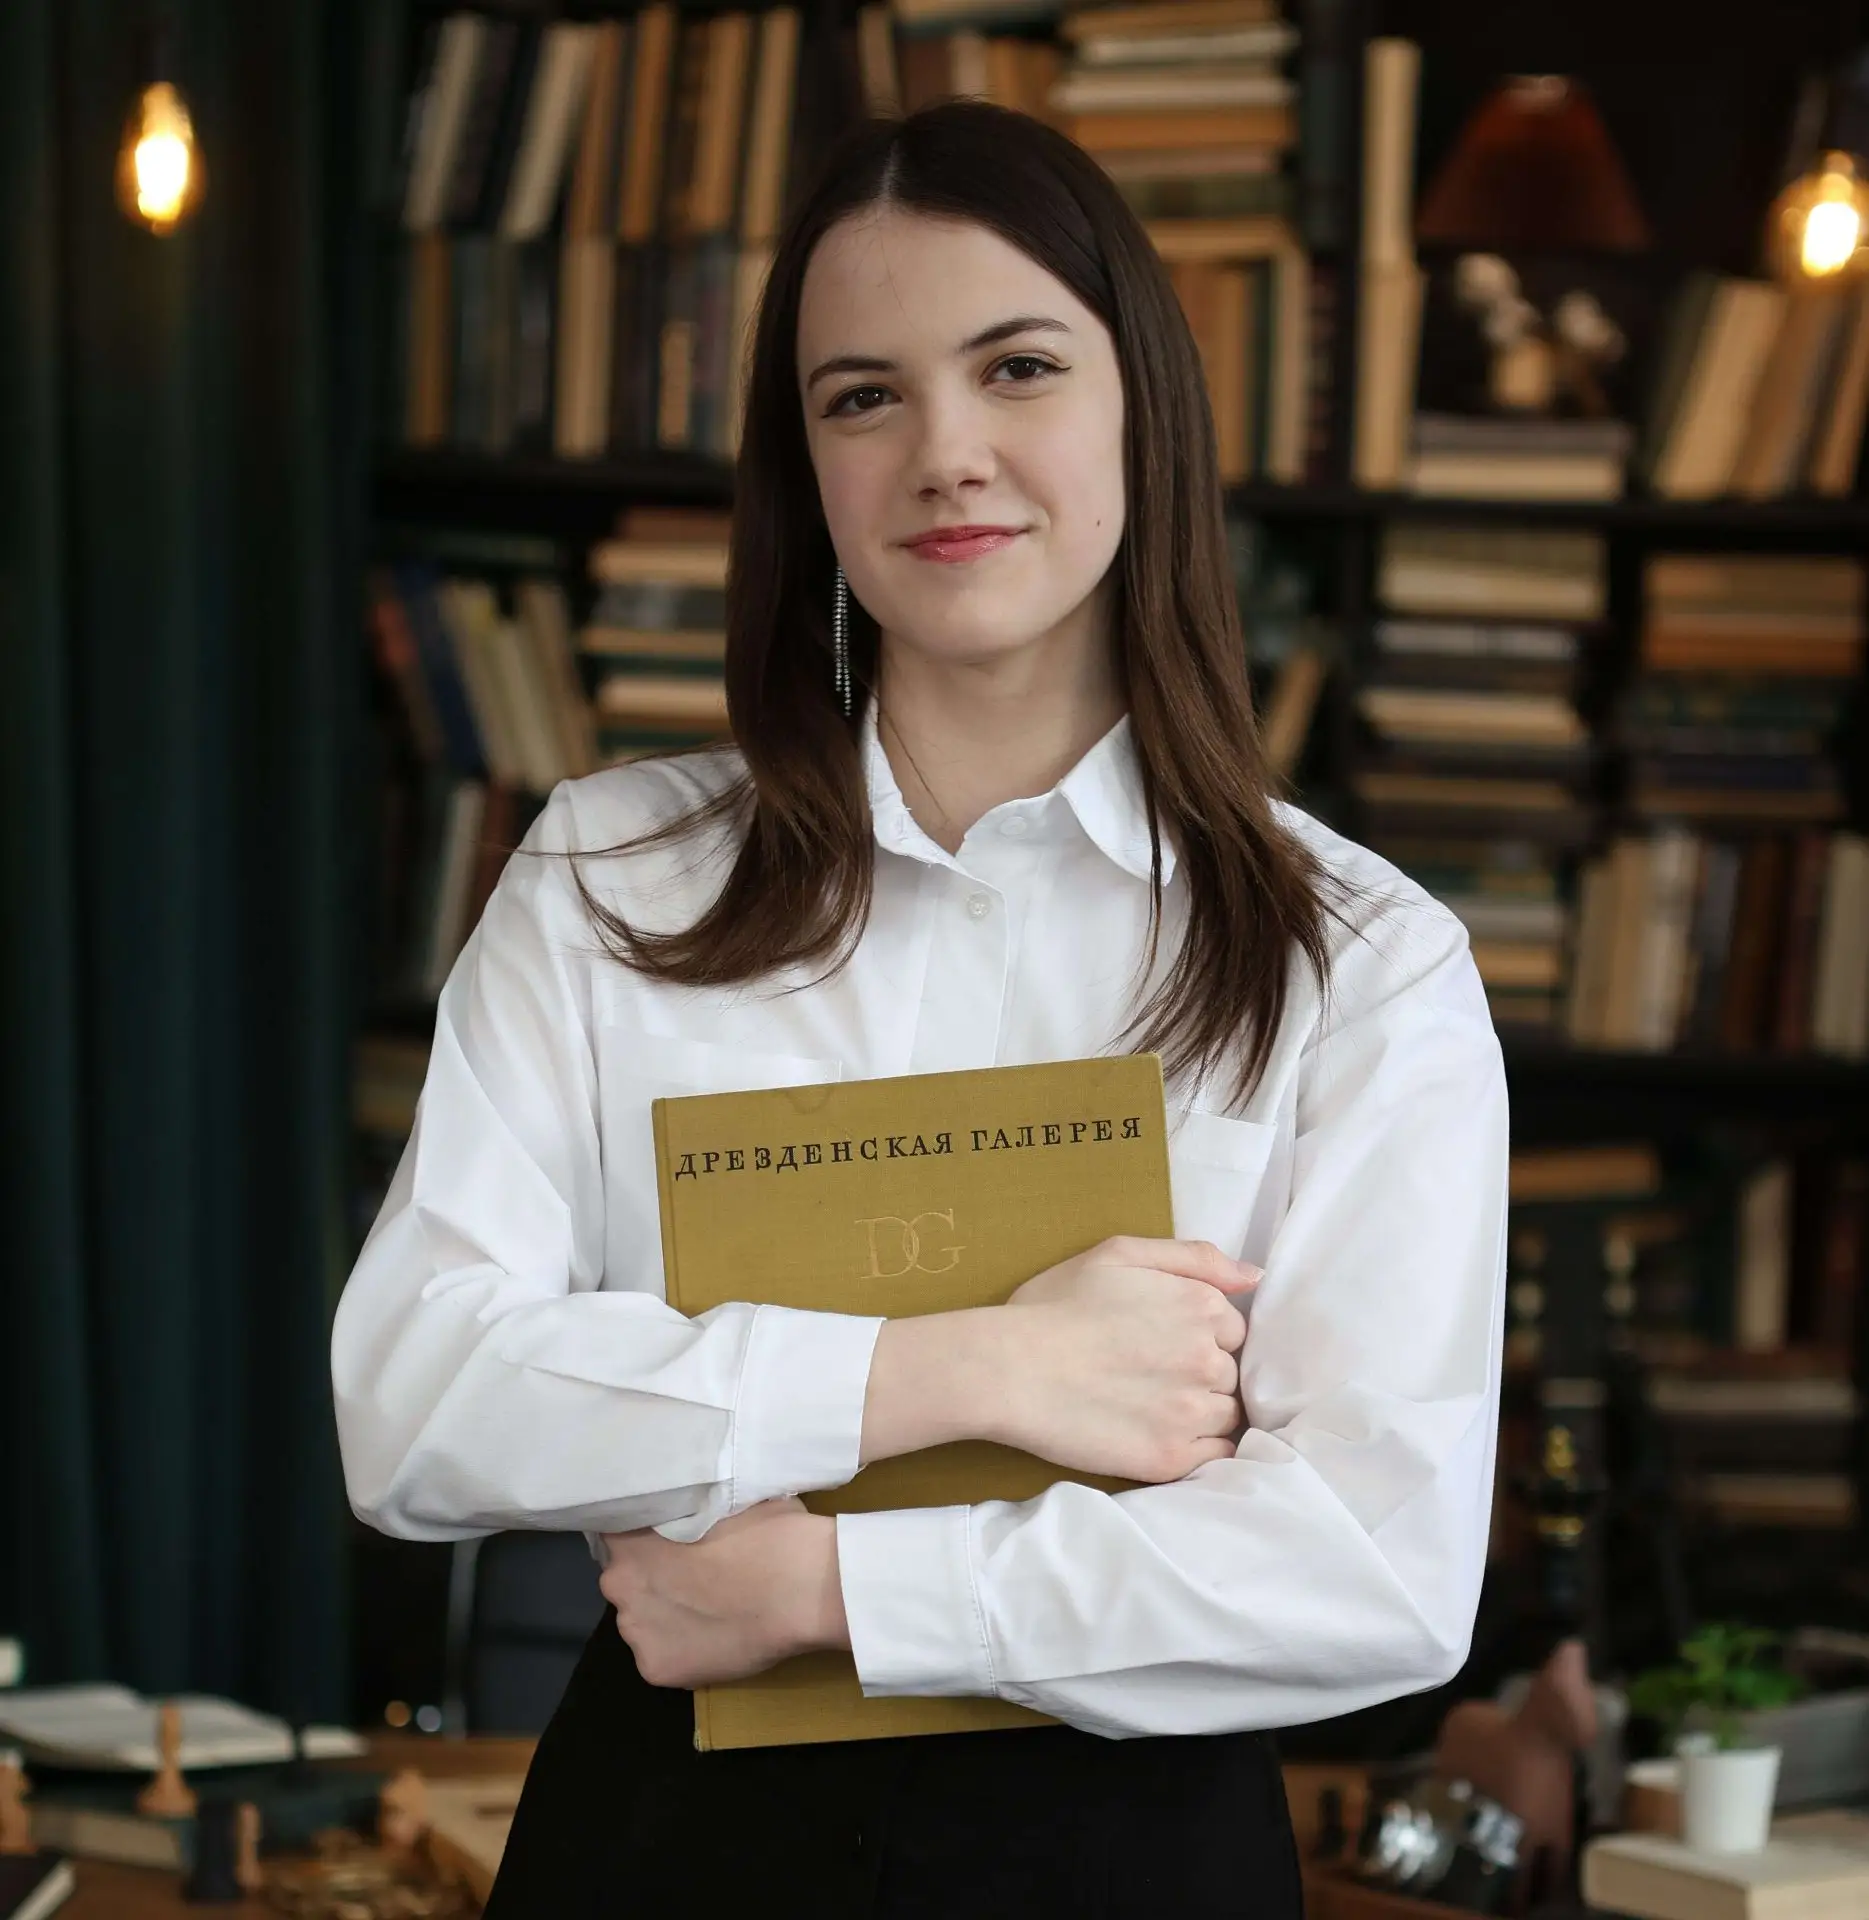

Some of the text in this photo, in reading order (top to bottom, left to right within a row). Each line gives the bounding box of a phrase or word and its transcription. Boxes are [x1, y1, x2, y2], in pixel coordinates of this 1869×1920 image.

[675, 1117, 1142, 1181] ДРЕЗДЕНСКАЯ ГАЛЕРЕЯ
[854, 1208, 967, 1279] DG
